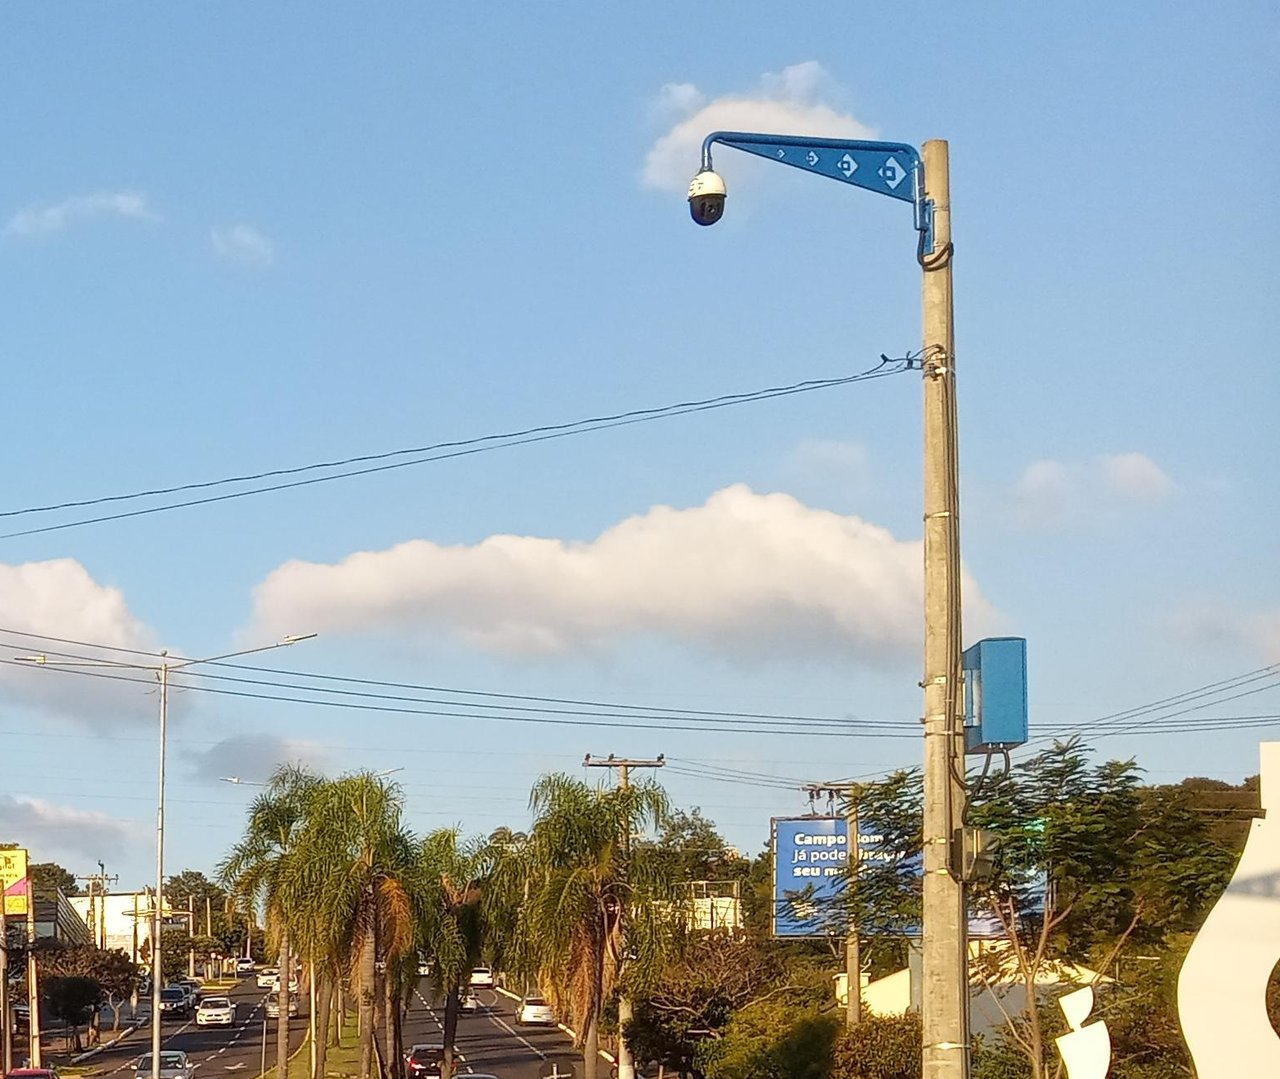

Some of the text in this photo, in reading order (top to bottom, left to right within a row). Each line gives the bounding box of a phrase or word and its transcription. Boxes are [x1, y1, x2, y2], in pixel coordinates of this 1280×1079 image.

[794, 833, 846, 847] Campo
[792, 849, 807, 863] já
[810, 849, 846, 862] pode
[793, 866, 820, 877] seu
